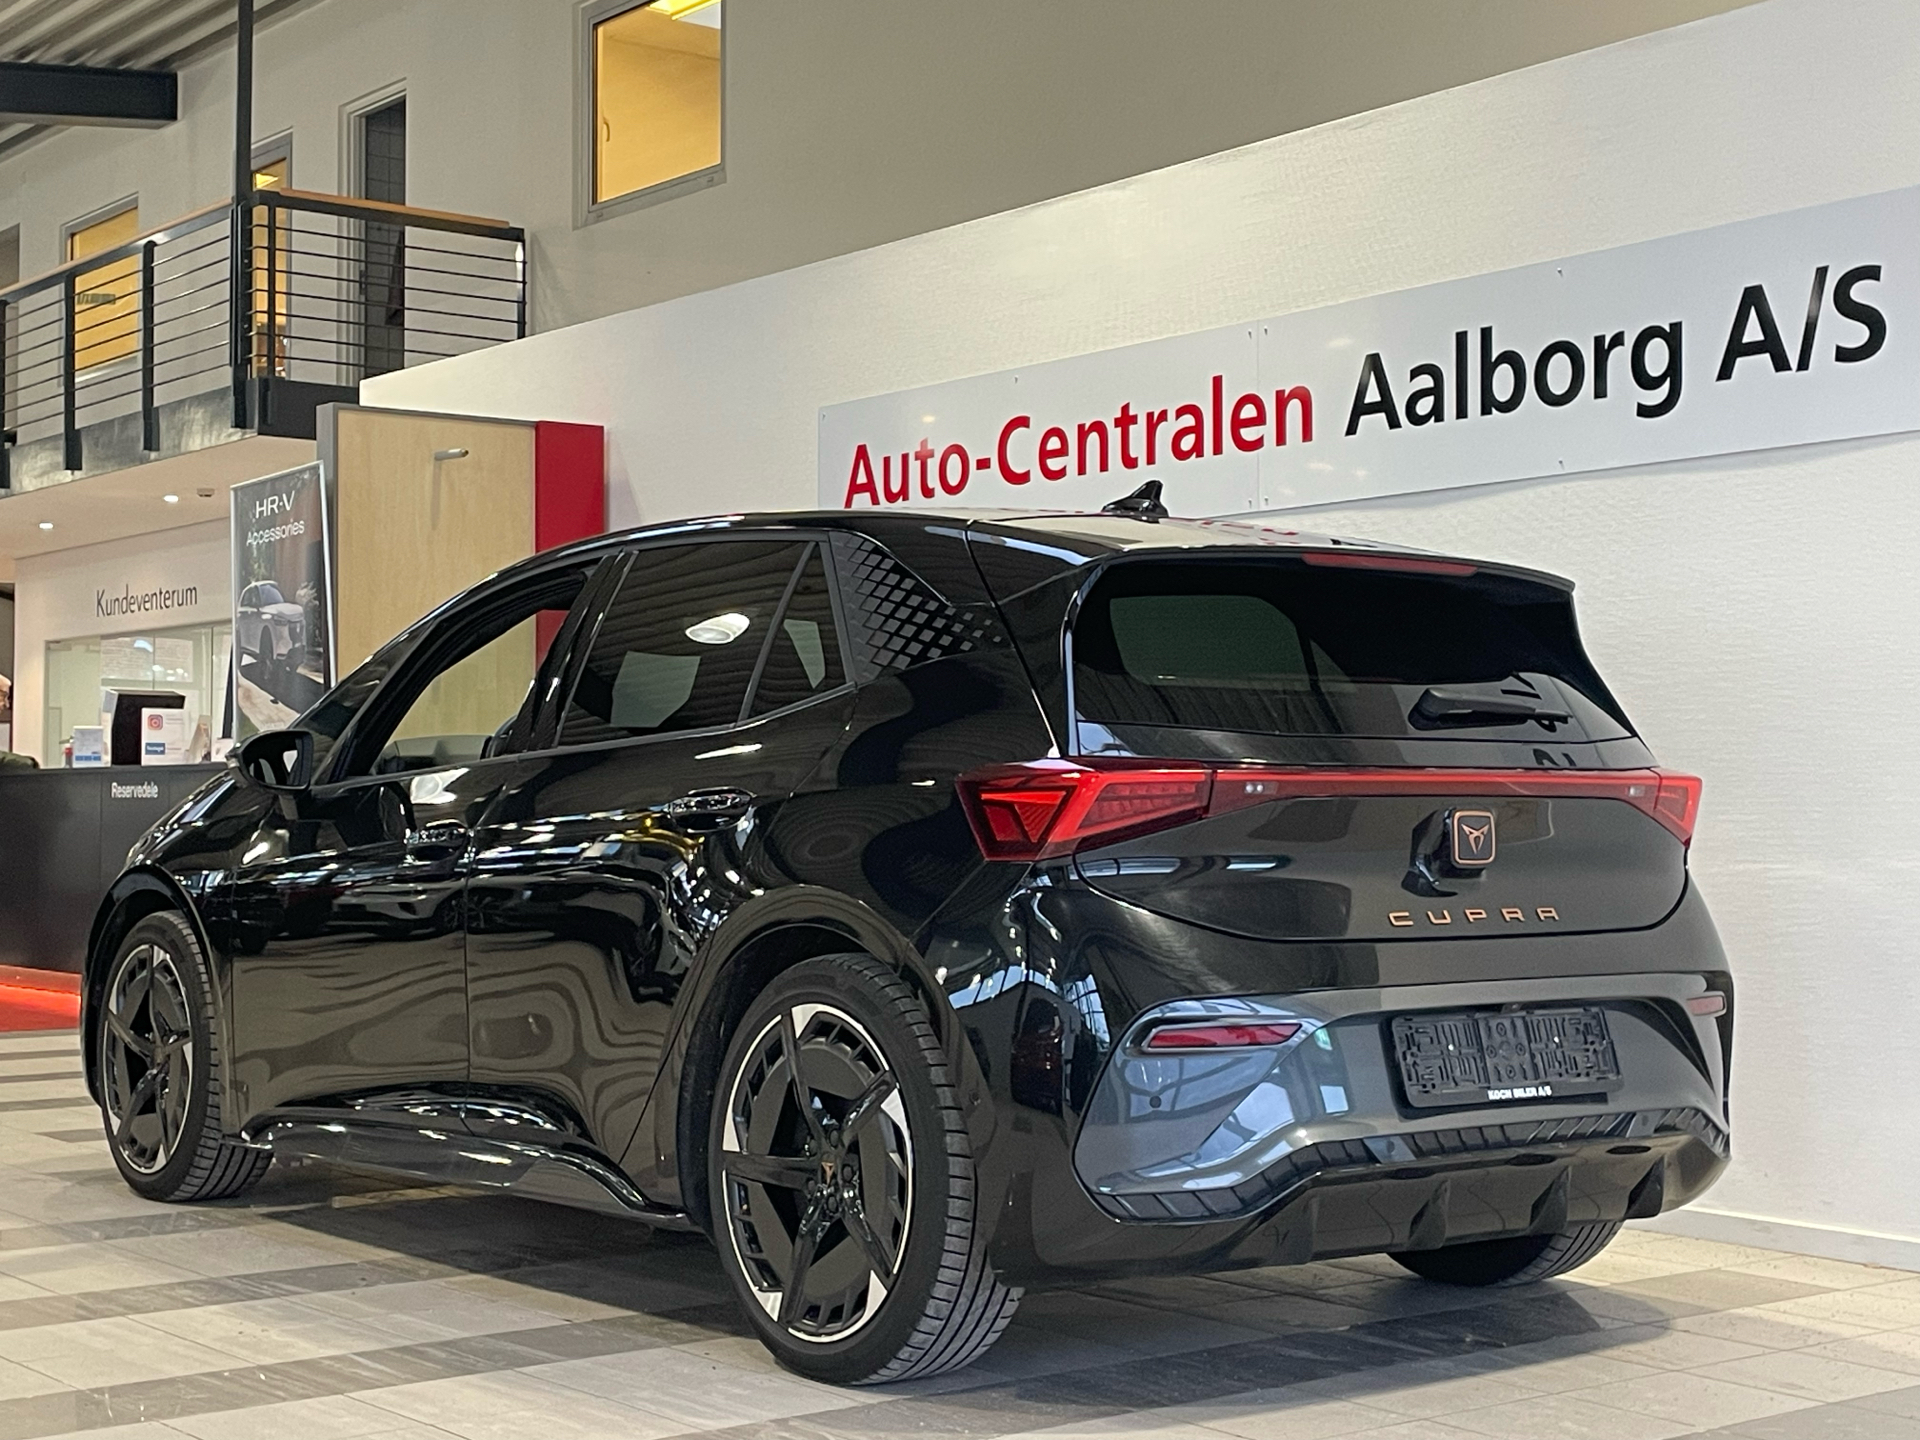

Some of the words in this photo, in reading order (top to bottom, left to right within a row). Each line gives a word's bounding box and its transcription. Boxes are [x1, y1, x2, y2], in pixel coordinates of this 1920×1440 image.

[844, 374, 1313, 508] Auto-Centralen
[1344, 320, 1683, 437] Aalborg
[1715, 264, 1887, 382] A/S
[246, 518, 305, 546] Accessories
[96, 583, 198, 617] Kundeventerum
[111, 781, 159, 798] Reservedele
[1388, 908, 1560, 927] CUPRA
